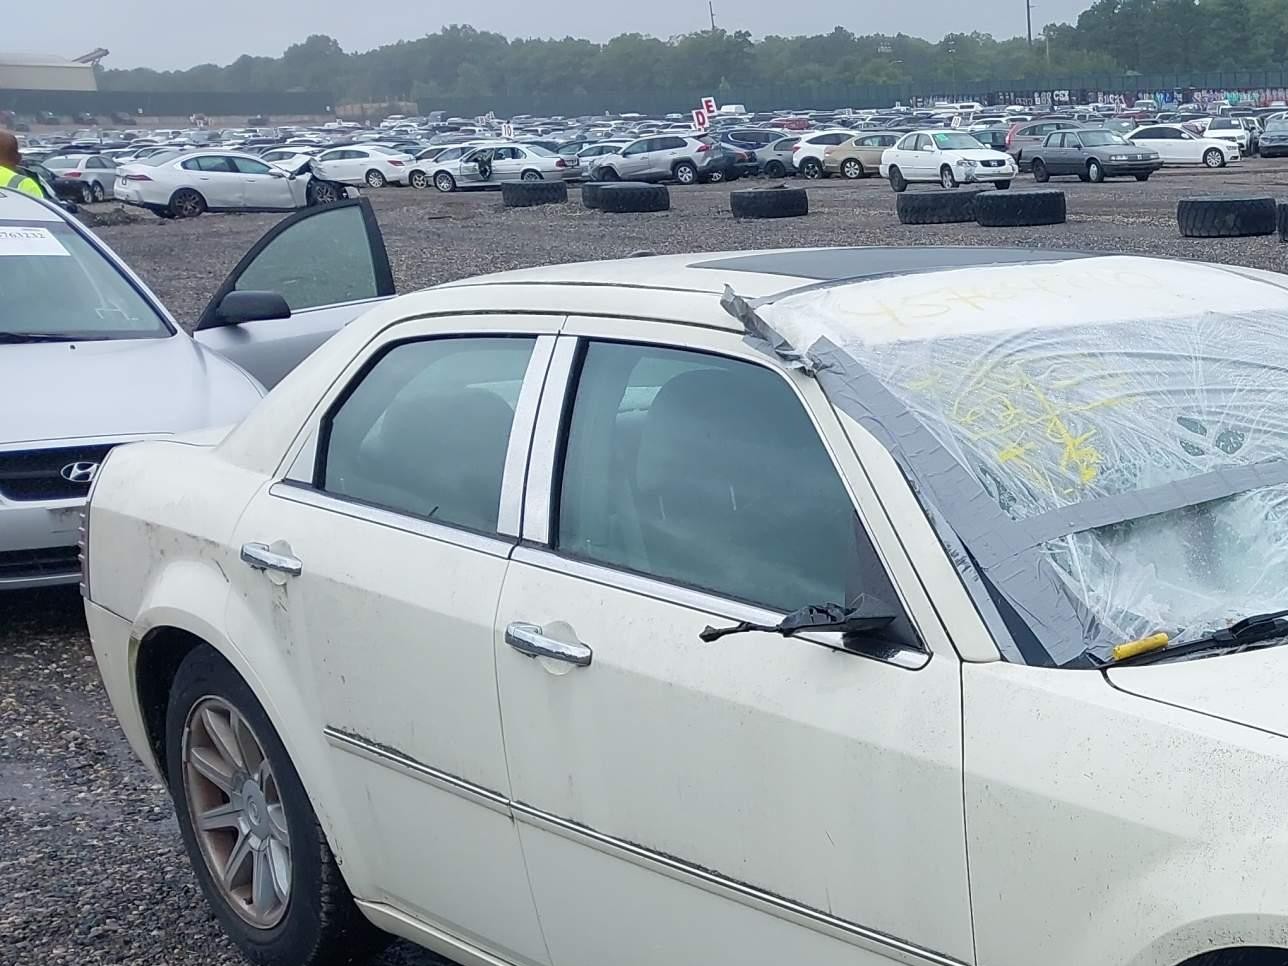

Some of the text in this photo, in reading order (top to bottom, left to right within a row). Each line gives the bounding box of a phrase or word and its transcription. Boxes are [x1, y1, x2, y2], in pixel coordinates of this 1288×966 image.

[704, 99, 714, 113] E
[697, 113, 707, 127] D
[502, 124, 512, 137] 10
